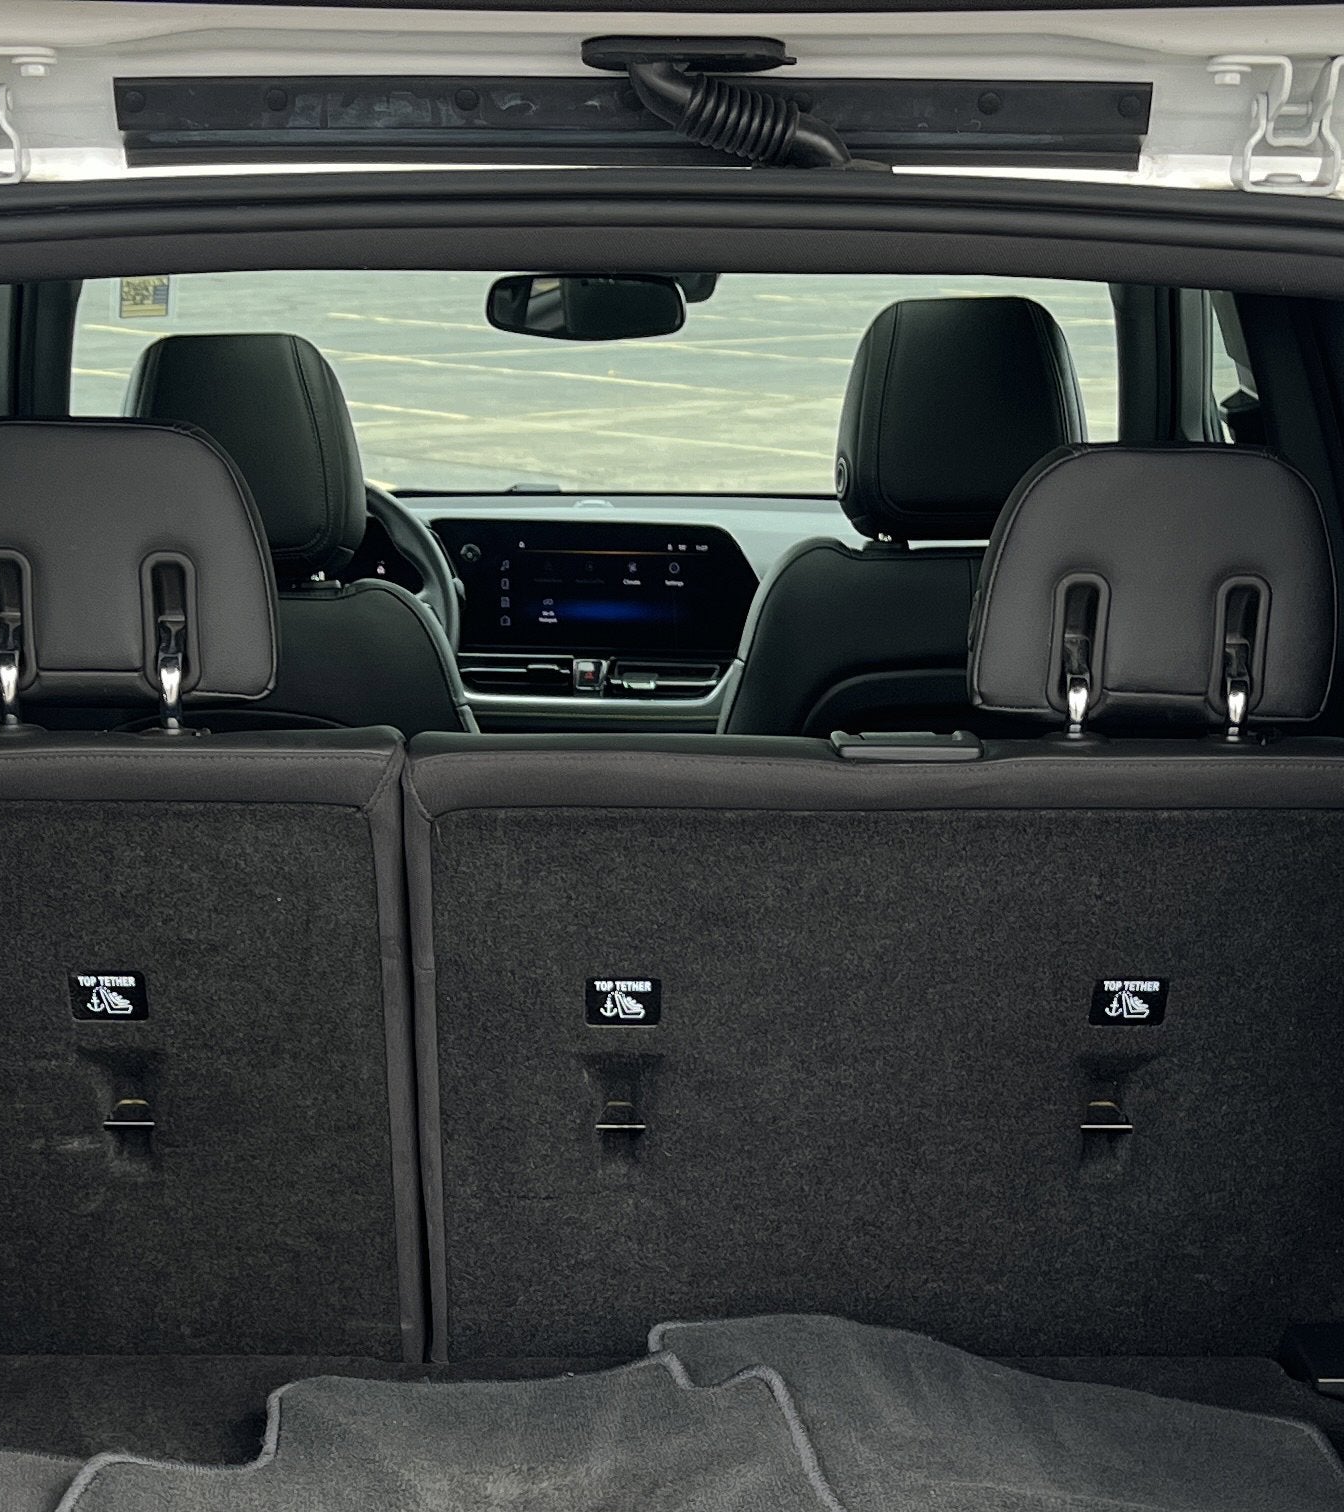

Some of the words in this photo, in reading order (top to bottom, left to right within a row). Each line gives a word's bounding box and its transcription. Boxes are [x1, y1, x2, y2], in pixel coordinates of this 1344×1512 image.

[77, 975, 97, 987] TOP
[97, 975, 136, 987] TETHER
[593, 980, 614, 992] TOP
[615, 980, 652, 992] TETHER
[1103, 980, 1123, 992] TOP
[1123, 980, 1160, 992] TETHER
